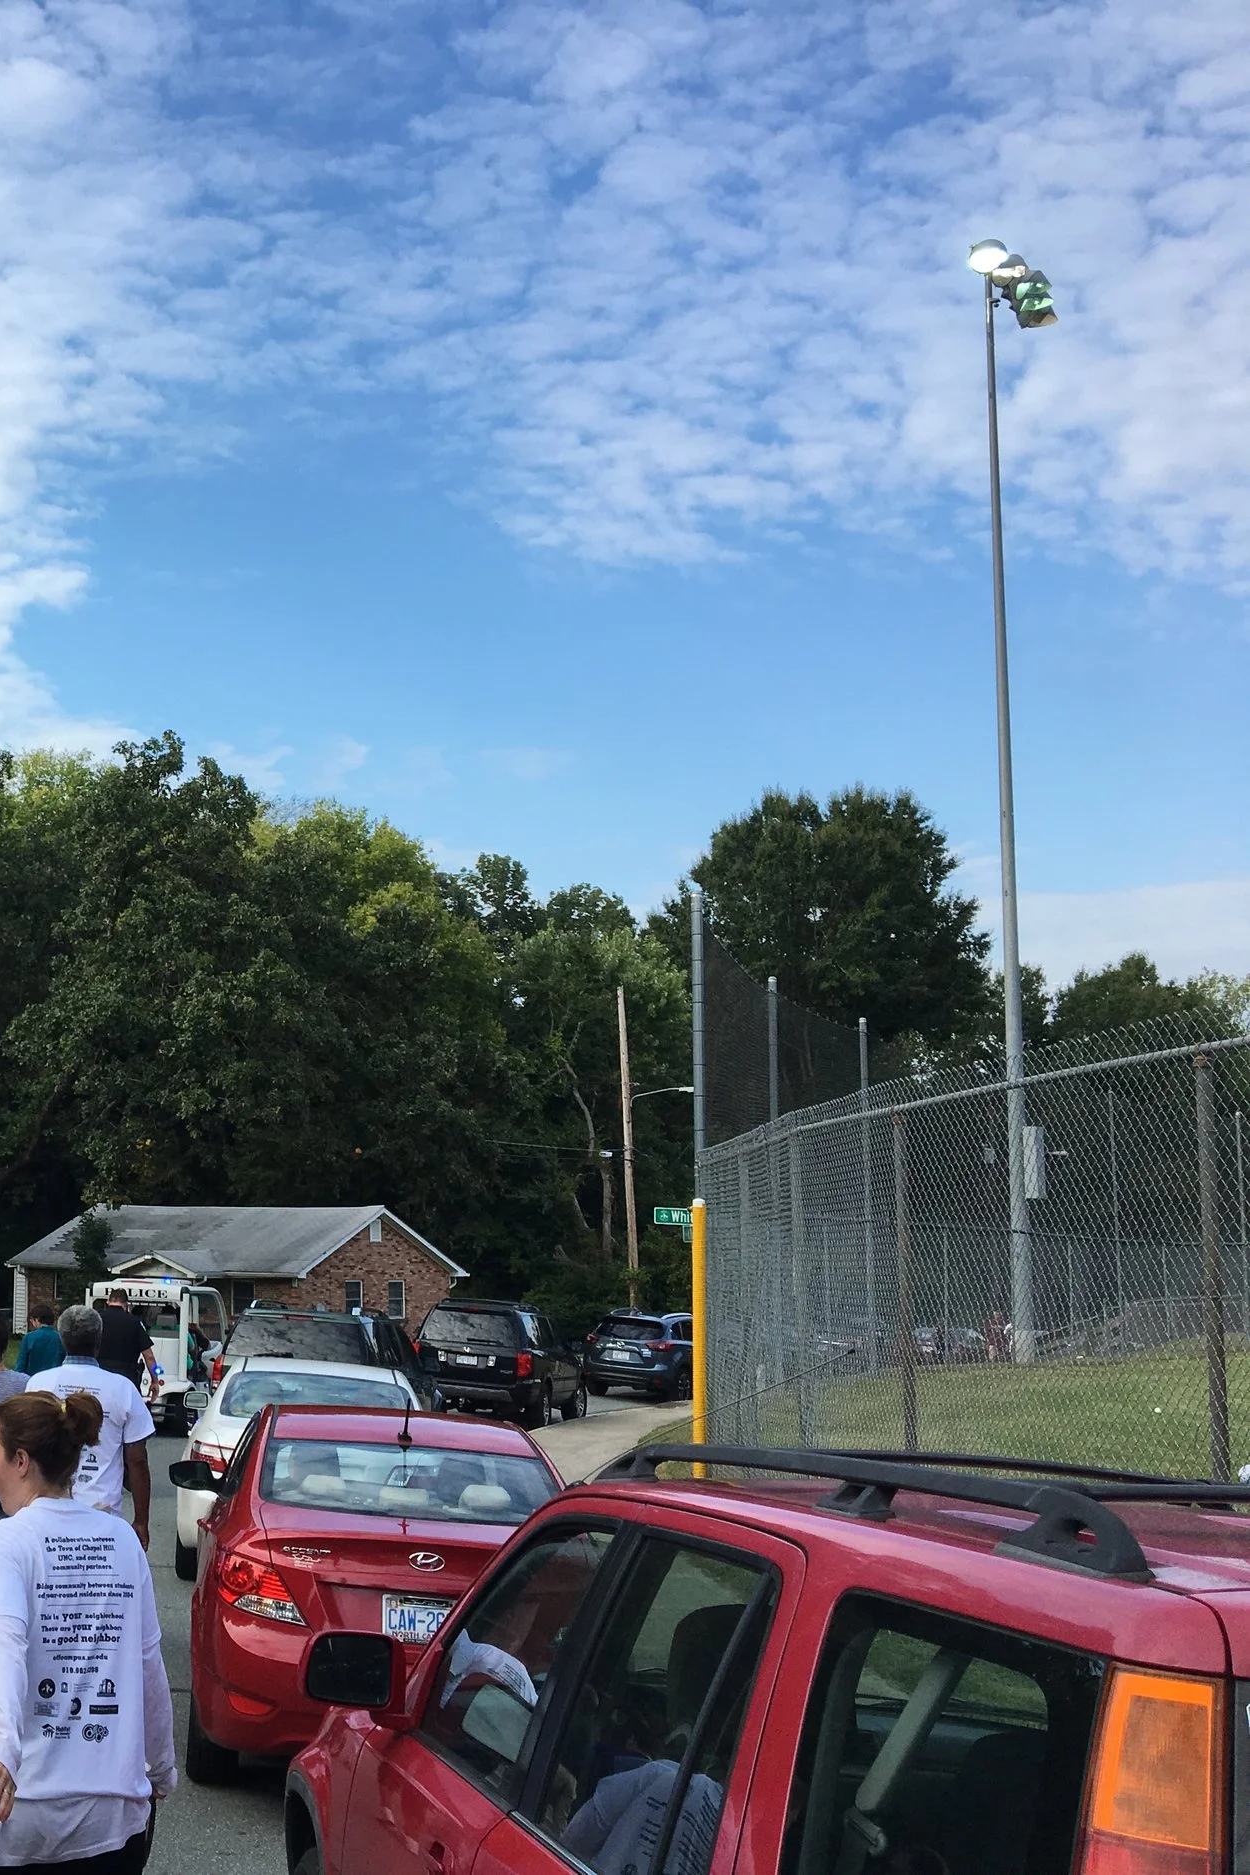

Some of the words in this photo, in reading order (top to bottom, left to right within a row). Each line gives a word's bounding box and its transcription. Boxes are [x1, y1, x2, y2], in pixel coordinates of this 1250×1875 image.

[105, 1287, 168, 1299] PLICE
[87, 1554, 107, 1562] caring
[62, 1613, 82, 1622] your
[72, 1624, 92, 1633] your
[57, 1634, 78, 1645] good
[392, 1631, 419, 1639] NORTH
